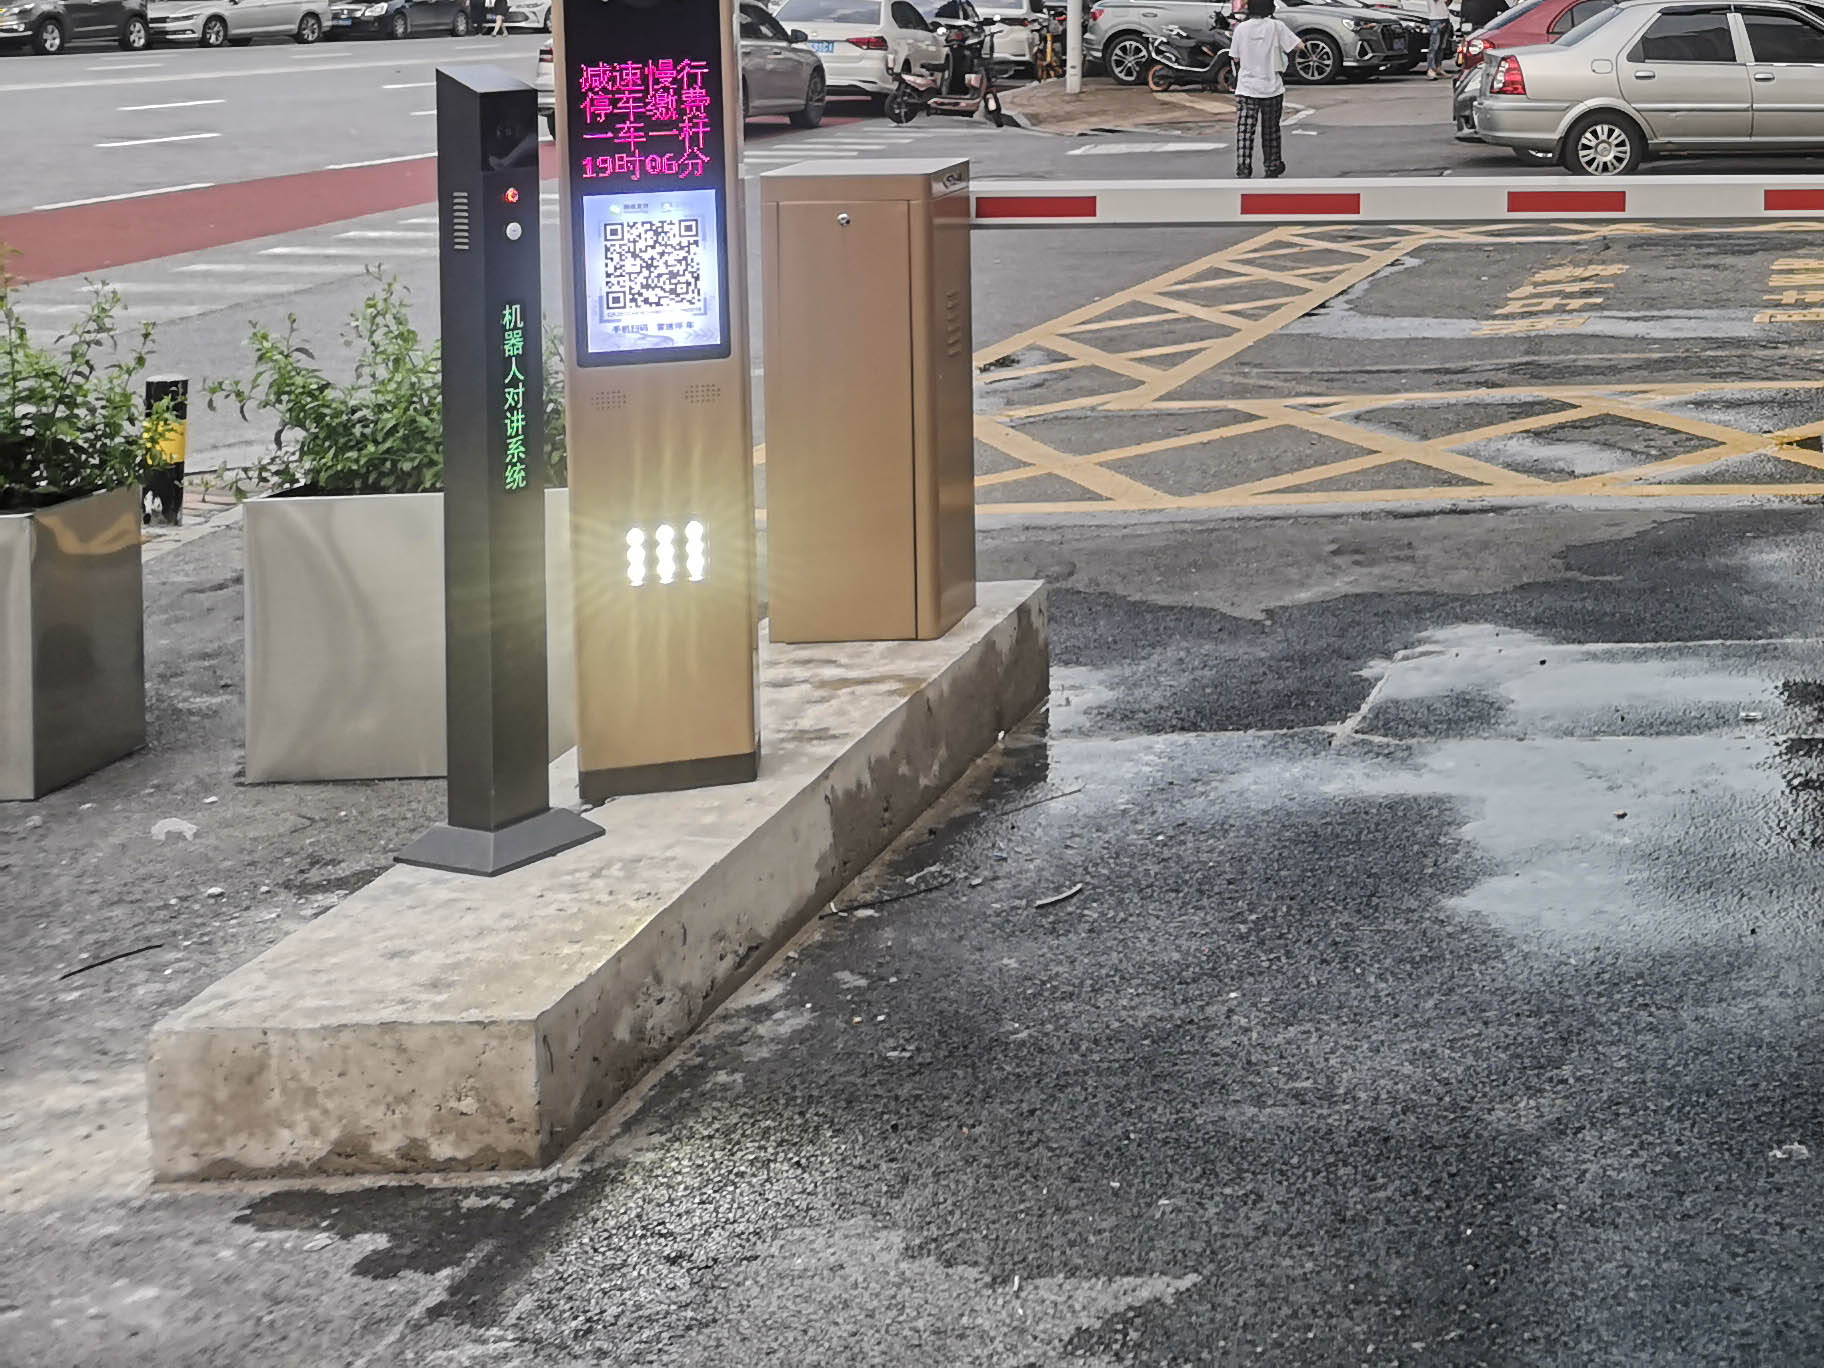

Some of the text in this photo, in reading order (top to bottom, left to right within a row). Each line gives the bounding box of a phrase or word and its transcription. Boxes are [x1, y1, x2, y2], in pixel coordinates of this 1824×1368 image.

[580, 59, 710, 95] 减速慢行
[580, 87, 711, 123] 停车缴费
[582, 117, 711, 152] 一车一杆
[582, 148, 711, 180] 19时06分
[501, 304, 527, 491] 机器人对讲系统
